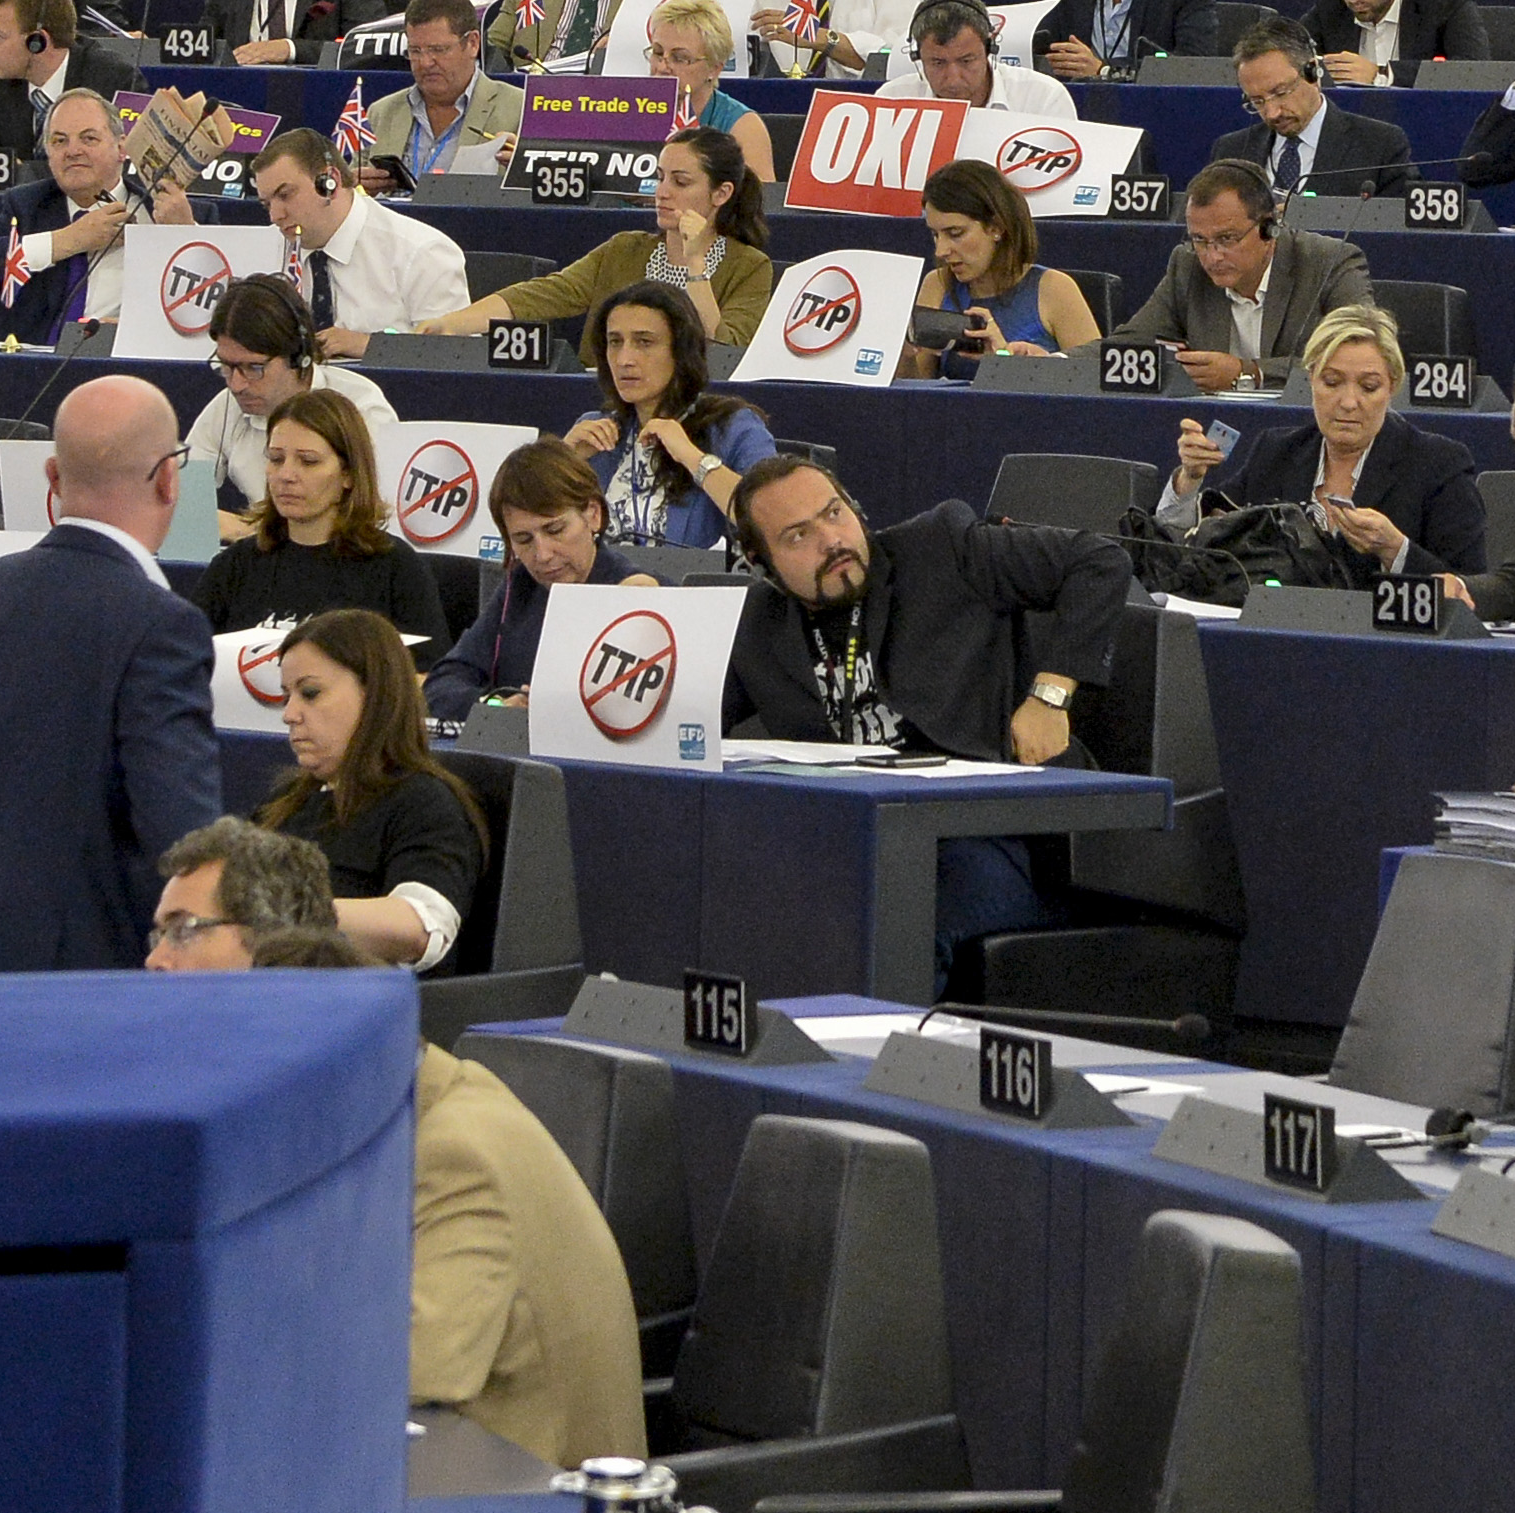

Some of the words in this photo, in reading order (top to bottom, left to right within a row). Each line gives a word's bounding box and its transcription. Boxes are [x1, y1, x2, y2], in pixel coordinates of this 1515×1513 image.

[164, 29, 211, 58] 434
[353, 31, 405, 57] TTI
[532, 96, 575, 113] Free
[577, 96, 632, 114] Trade
[635, 97, 669, 115] Yes
[231, 121, 263, 138] Yes
[809, 102, 943, 192] OXI
[606, 152, 657, 178] NO
[1005, 140, 1073, 174] TTIP
[536, 166, 585, 198] 355
[1113, 181, 1164, 213] 357
[1409, 187, 1459, 222] 358
[169, 267, 227, 312] TTIP
[791, 293, 852, 333] TTIP
[493, 325, 542, 361] 281
[1104, 348, 1156, 383] 283
[1413, 362, 1467, 399] 284
[406, 467, 468, 519] TTIP
[1377, 580, 1432, 623] 218
[590, 642, 665, 704] TTIP
[691, 983, 738, 1044] 115
[985, 1037, 1032, 1107] 116
[1269, 1111, 1316, 1175] 117
